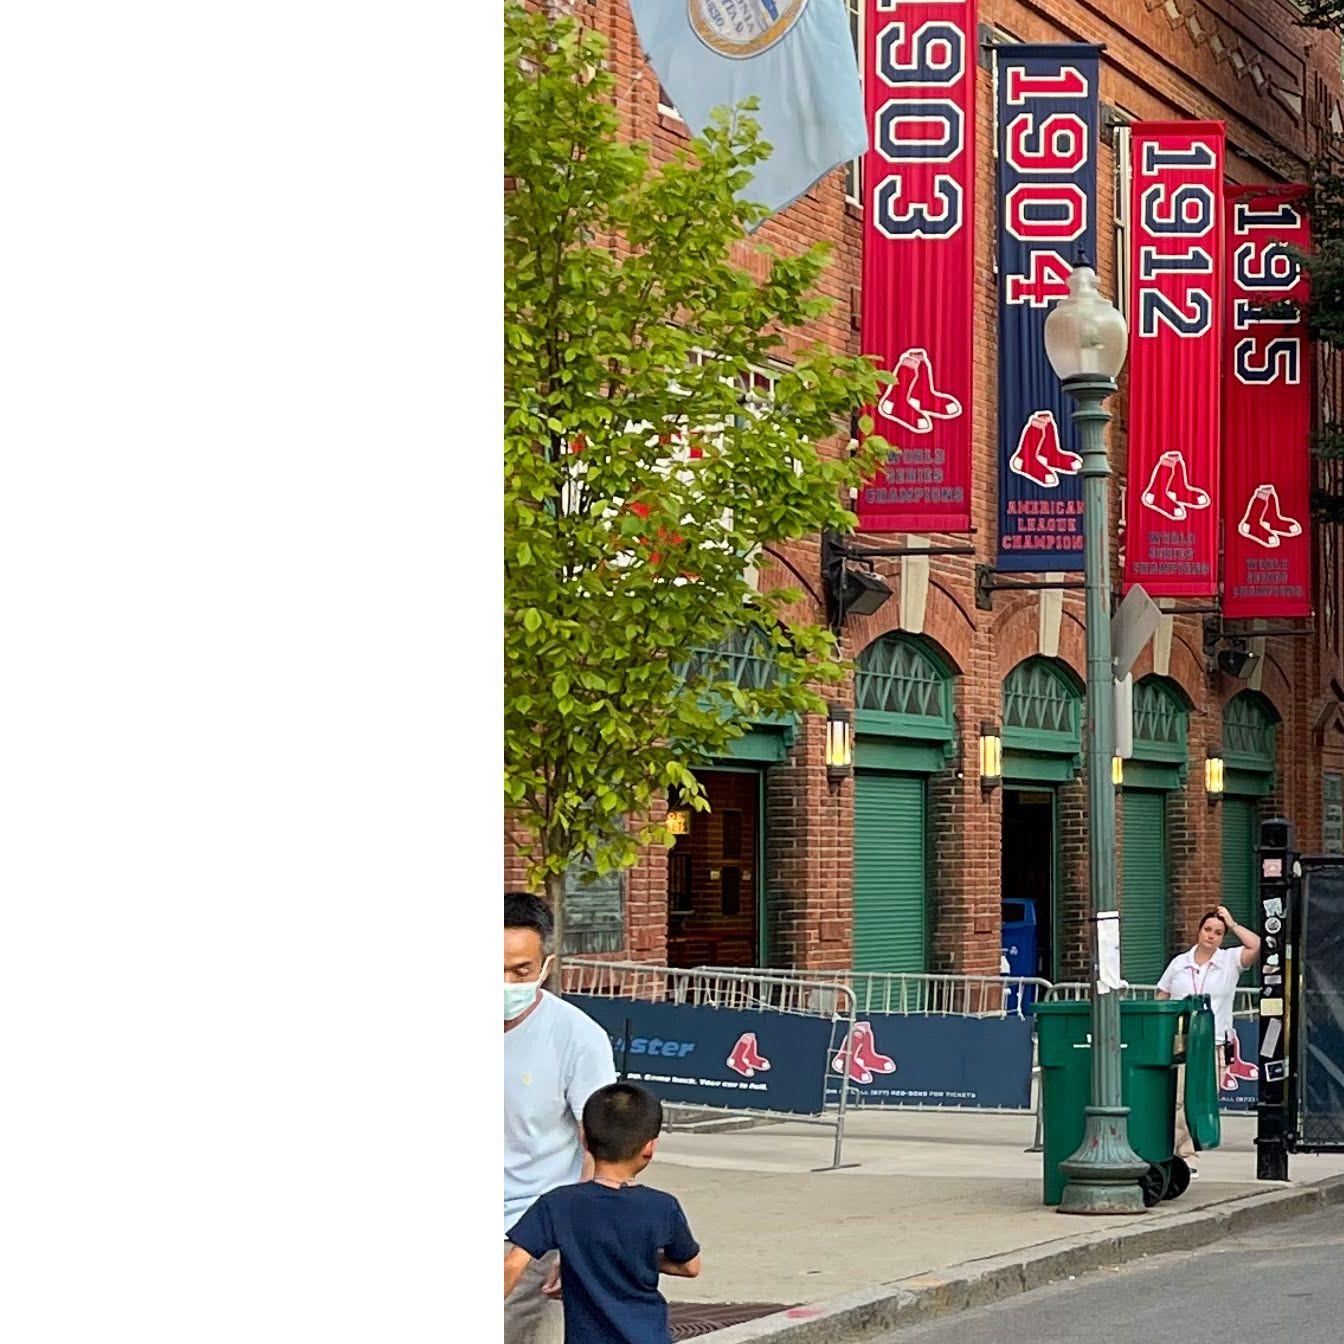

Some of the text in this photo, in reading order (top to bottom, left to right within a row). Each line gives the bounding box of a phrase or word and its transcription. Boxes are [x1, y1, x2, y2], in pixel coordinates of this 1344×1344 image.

[1005, 65, 1090, 309] 1904
[1138, 140, 1217, 339] 1912
[1234, 202, 1302, 385] 1915
[1001, 535, 1084, 550] CHAMPION
[1006, 500, 1085, 515] AMERICAN
[1017, 517, 1077, 532] LEAGUE
